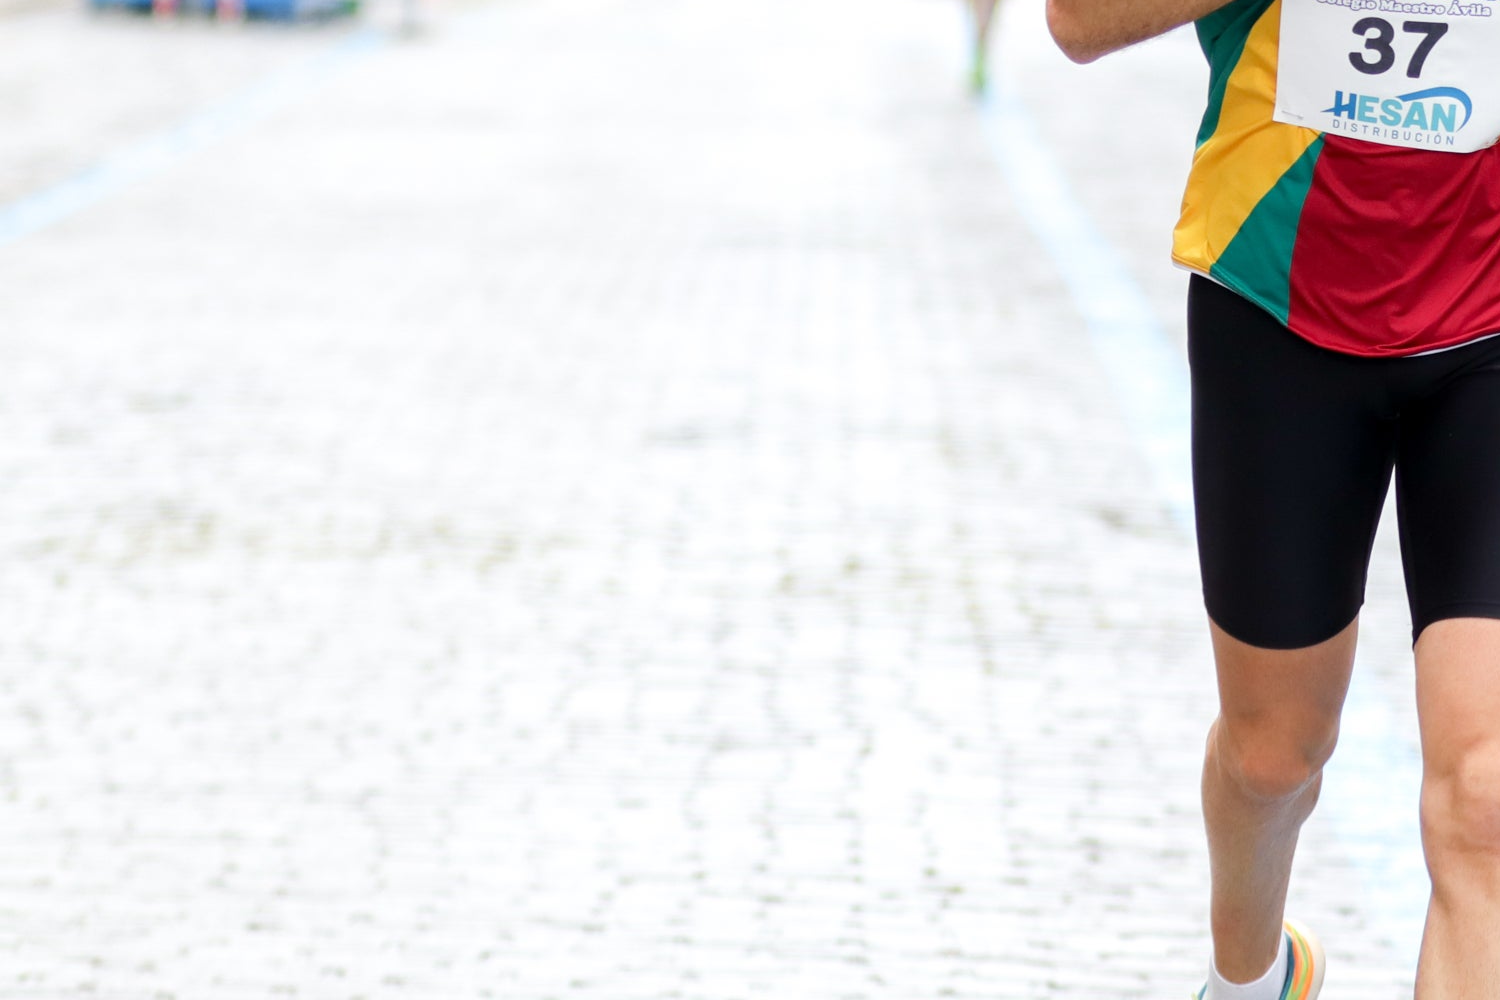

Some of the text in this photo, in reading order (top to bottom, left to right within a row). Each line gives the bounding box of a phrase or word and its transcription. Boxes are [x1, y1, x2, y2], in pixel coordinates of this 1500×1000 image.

[1447, 0, 1491, 17] Ávila
[1348, 17, 1449, 78] 37
[1330, 90, 1457, 132] HESAN
[1332, 119, 1455, 146] DISTRIBUCIÓN
